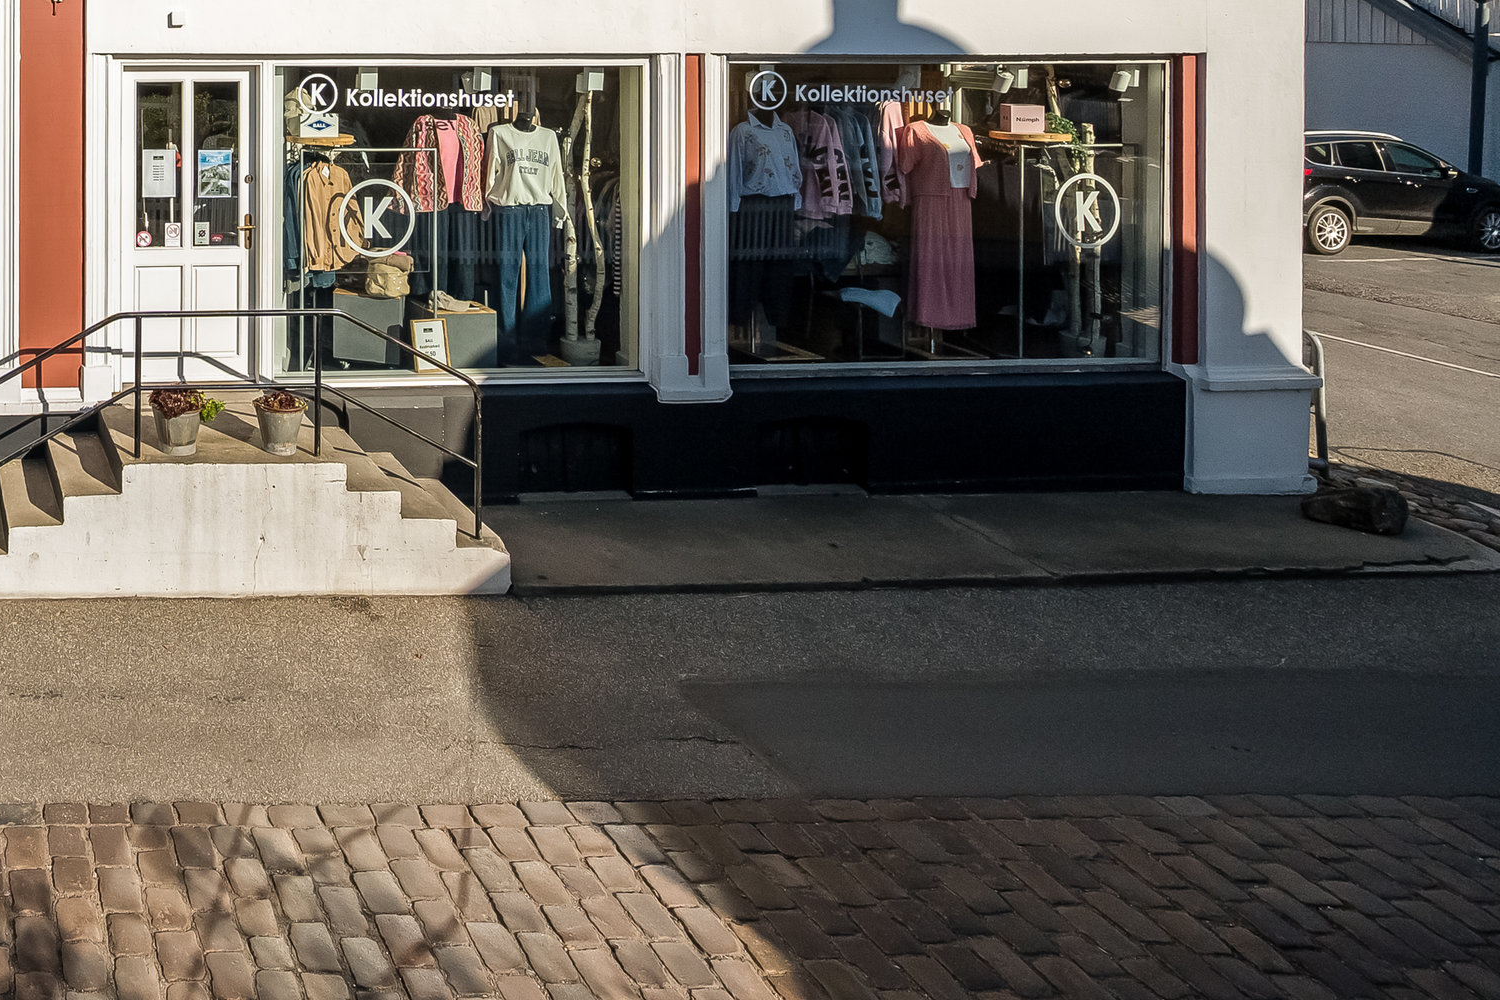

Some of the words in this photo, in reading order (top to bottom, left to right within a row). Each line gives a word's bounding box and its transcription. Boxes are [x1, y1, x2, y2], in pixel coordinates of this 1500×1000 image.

[310, 83, 327, 106] K
[346, 88, 514, 108] Kollektionshuset
[761, 79, 777, 102] K
[795, 83, 954, 104] Kollektionshuset
[1015, 116, 1040, 124] Nümph
[363, 196, 393, 239] K
[1075, 191, 1103, 233] K
